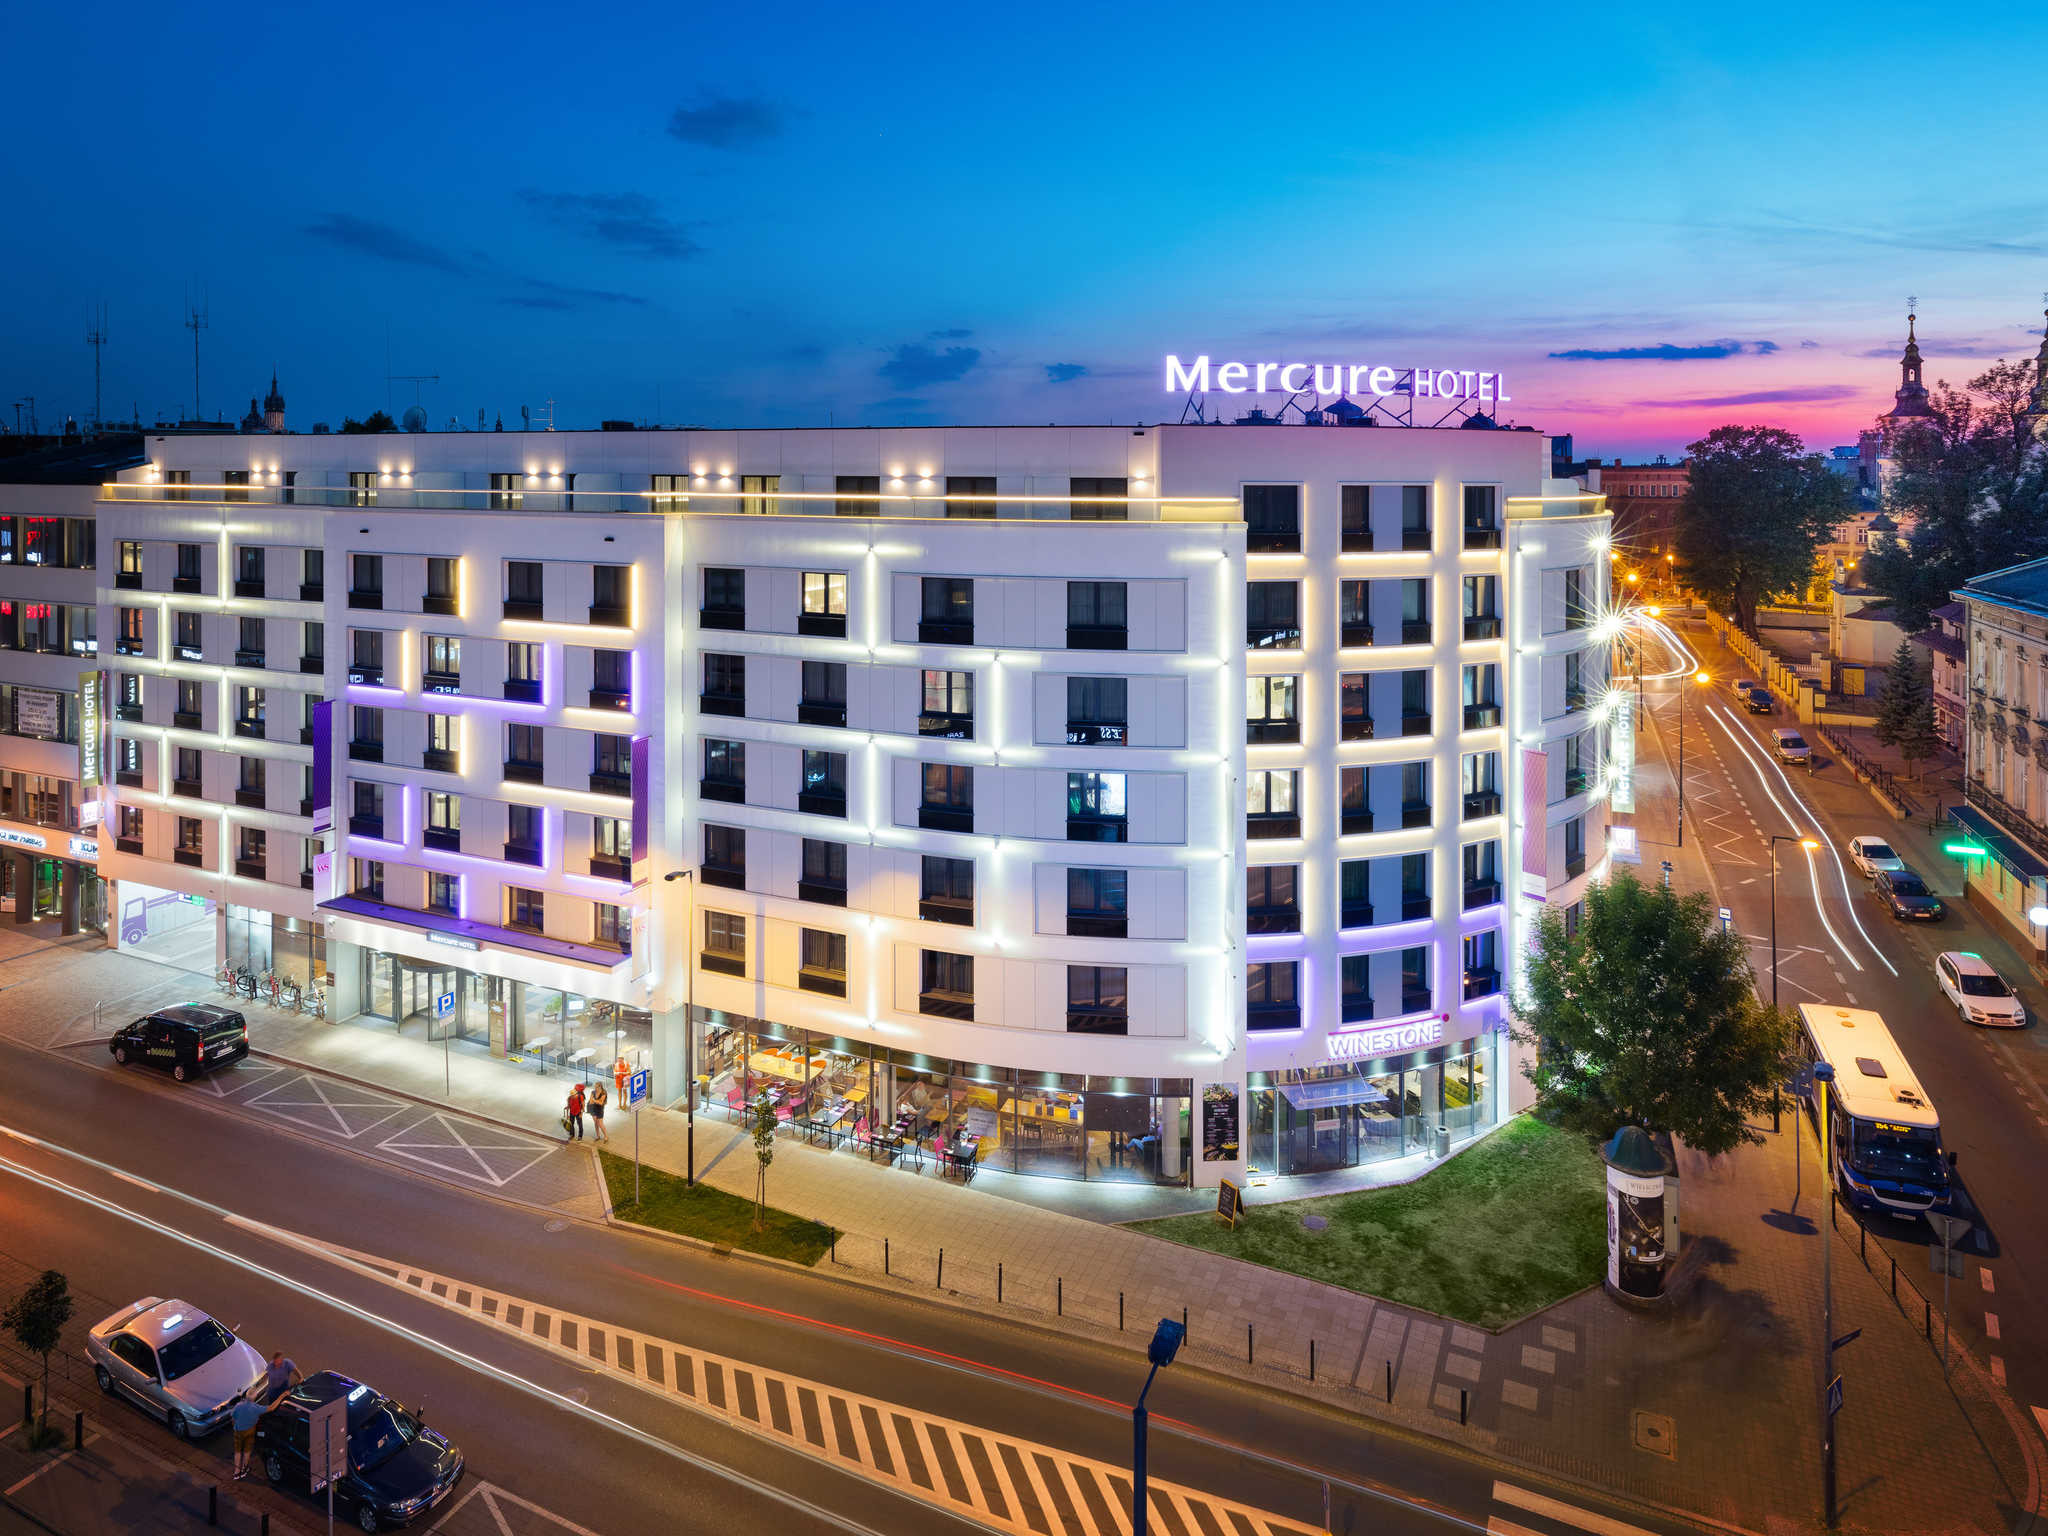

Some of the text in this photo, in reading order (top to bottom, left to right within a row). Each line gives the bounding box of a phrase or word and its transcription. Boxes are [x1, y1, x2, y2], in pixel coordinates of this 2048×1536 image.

[1165, 355, 1511, 401] Mercure HOTEL
[83, 680, 95, 780] Mercure HOTEL
[441, 995, 451, 1011] P
[1330, 1022, 1441, 1057] WINESTONE
[633, 1074, 643, 1095] P
